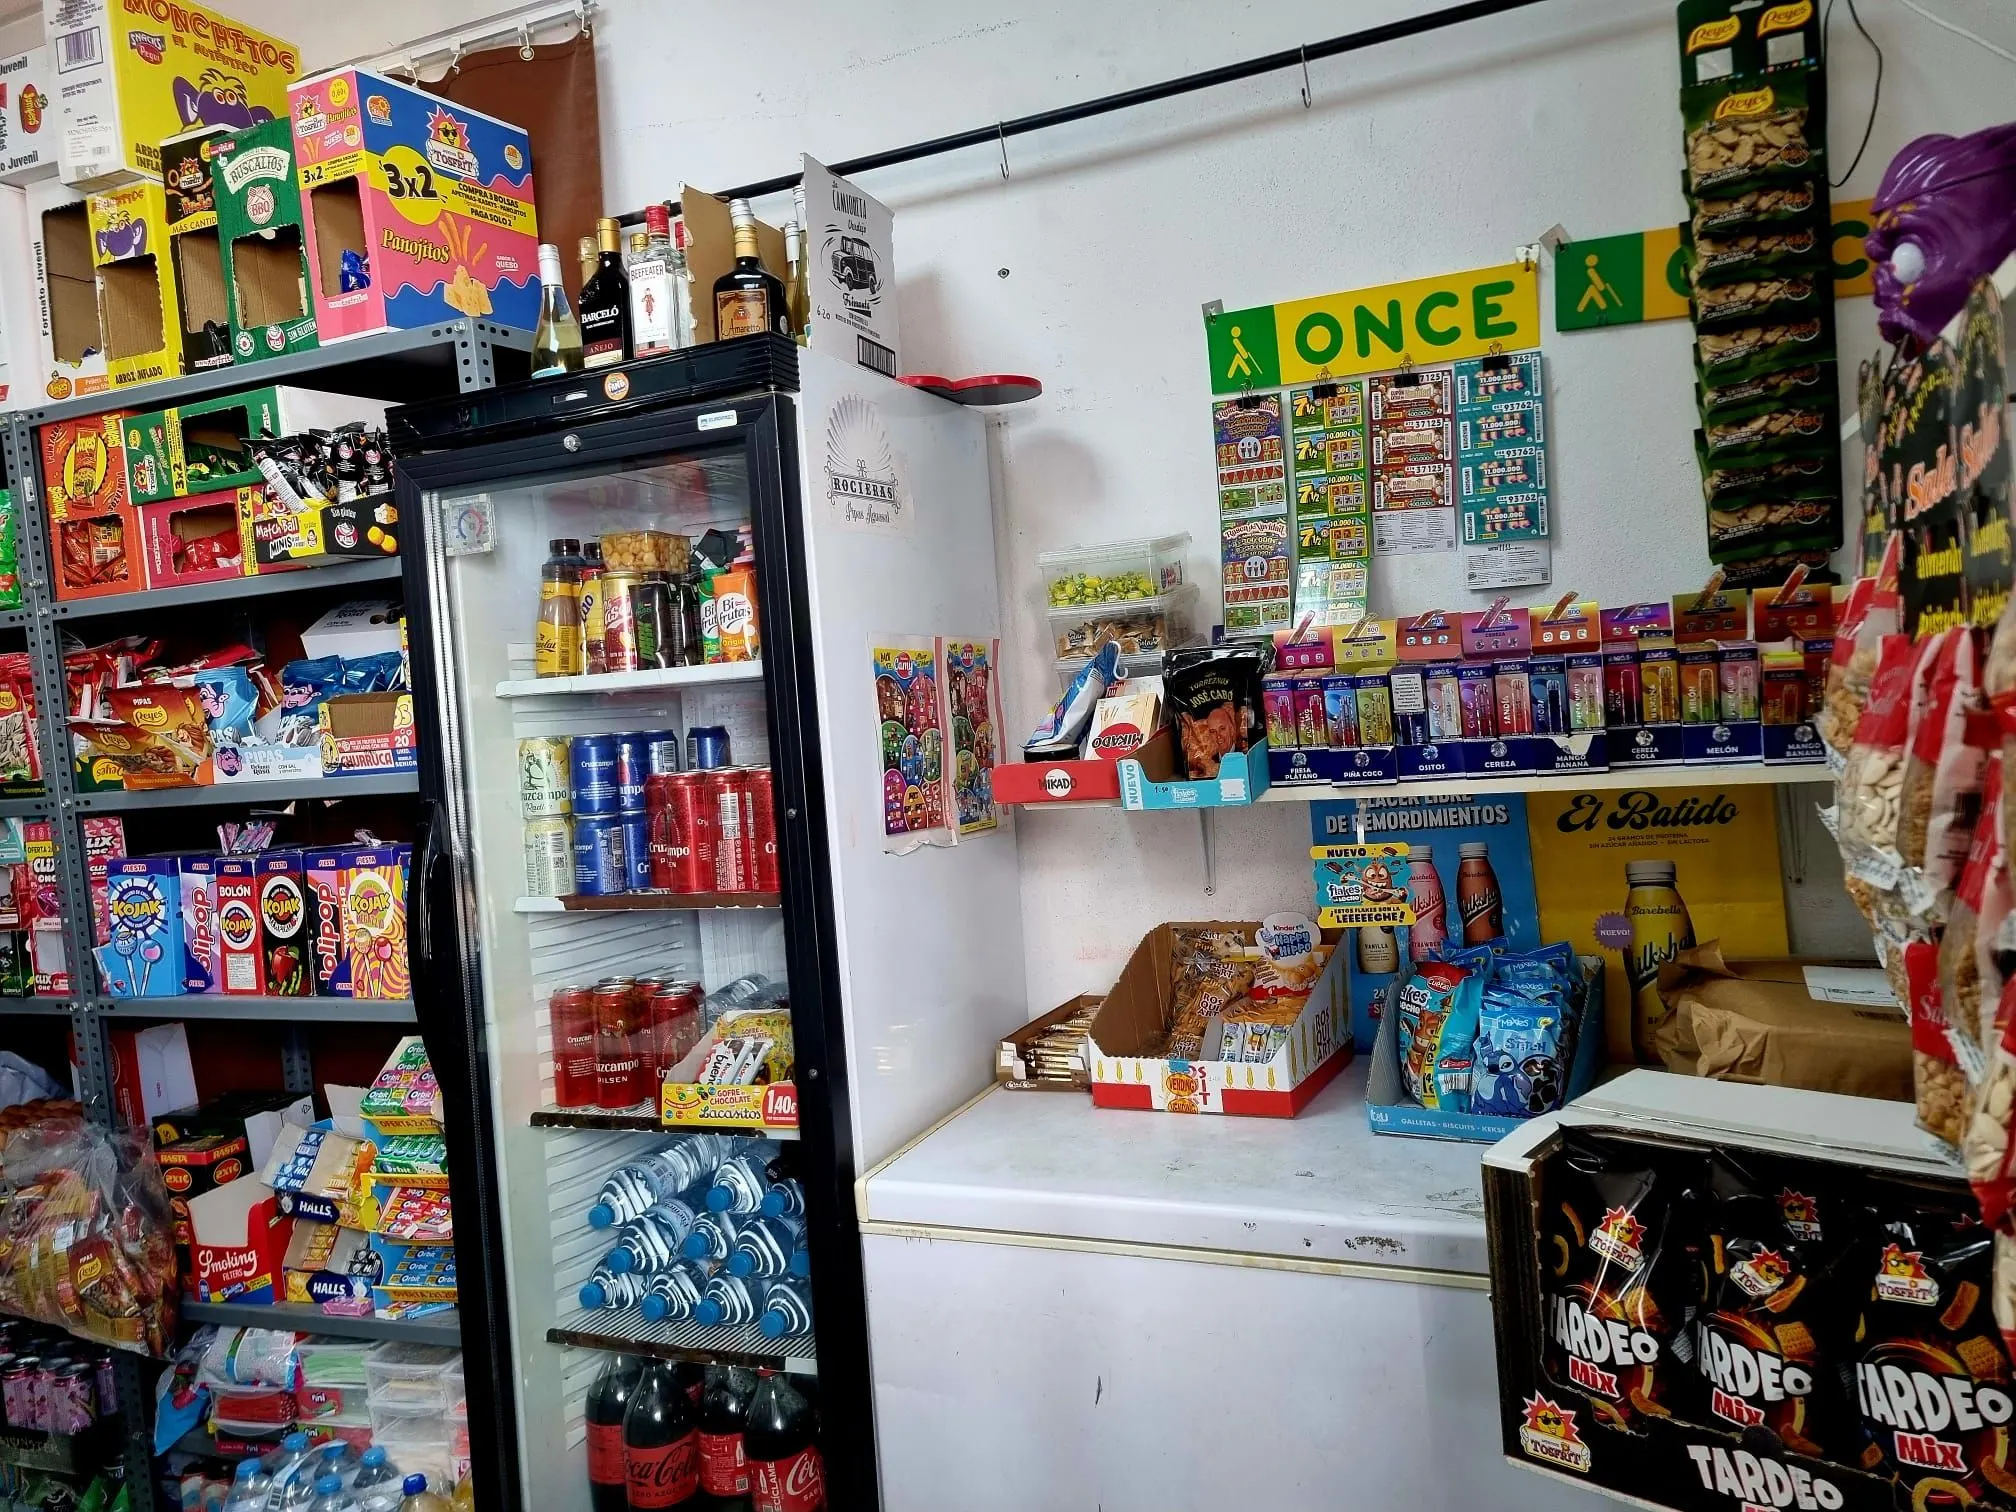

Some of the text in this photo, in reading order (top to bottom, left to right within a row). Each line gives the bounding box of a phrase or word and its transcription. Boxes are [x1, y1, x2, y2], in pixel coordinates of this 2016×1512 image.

[131, 32, 164, 51] SNACKS
[8, 150, 39, 169] Juvenil
[433, 150, 473, 173] TOSFRIT
[383, 162, 440, 199] 3x2
[251, 200, 271, 217] BBQ
[382, 228, 449, 265] Panojitos
[630, 264, 664, 281] BEEFEATER
[40, 288, 49, 337] Formato
[581, 305, 619, 324] BARCELÓ
[1295, 280, 1518, 366] ONCE
[1503, 402, 1532, 411] 93762
[1506, 448, 1535, 458] 93762
[833, 477, 893, 500] ROCIERAS
[1508, 495, 1537, 503] 93762
[269, 535, 292, 559] MINIS
[722, 598, 734, 611] Bi
[718, 606, 752, 628] frutas
[133, 697, 152, 706] PIPAS
[1190, 690, 1233, 708] JOSÉ CABO
[135, 711, 163, 724] Reyes
[1092, 734, 1144, 749] MIKADO
[1706, 745, 1739, 754] MELÓN
[1787, 742, 1821, 750] MANGO
[341, 753, 393, 769] CHURRUCA
[1556, 754, 1586, 762] MANGO
[1635, 752, 1656, 760] COLA
[1418, 763, 1445, 771] OSITOS
[1484, 760, 1516, 769] CEREZA
[1343, 769, 1383, 778] PIÑA COCO
[1039, 777, 1077, 790] MIKADO
[1126, 764, 1139, 804] NUEVO
[1556, 791, 1739, 833] El Batido
[1326, 814, 1349, 834] DE
[1326, 847, 1367, 858] NUEVO
[219, 885, 251, 897] BOLÓN
[1329, 884, 1361, 897] flakes
[112, 899, 161, 918] KOJAK
[263, 896, 300, 917] KOJAK
[350, 892, 391, 914] KOJAK
[1631, 905, 1682, 916] Barebells
[221, 918, 254, 932] KOJAK
[1275, 932, 1310, 947] Happy
[1279, 942, 1312, 958] Hippo
[368, 1090, 389, 1098] Orbit
[410, 1089, 431, 1098] Orbit
[709, 1095, 752, 1105] CHOCOLATE
[717, 1088, 740, 1098] GOFRE
[767, 1085, 798, 1115] 1,40€
[699, 1106, 761, 1119] Lacasitos
[1401, 1118, 1506, 1134] GALLETAS BISCUITS KEKSE
[299, 1200, 332, 1217] HALLS
[198, 1250, 257, 1277] Smoking
[222, 1269, 243, 1281] FILTERS
[312, 1282, 347, 1296] HALLS
[1877, 1280, 1933, 1300] TOSFRIT
[1569, 1356, 1619, 1399] Mix
[1712, 1388, 1765, 1427] Mix
[1531, 1440, 1583, 1467] TOSFRIT
[1895, 1432, 1968, 1472] Mix
[1688, 1445, 1844, 1510] TARDEO
